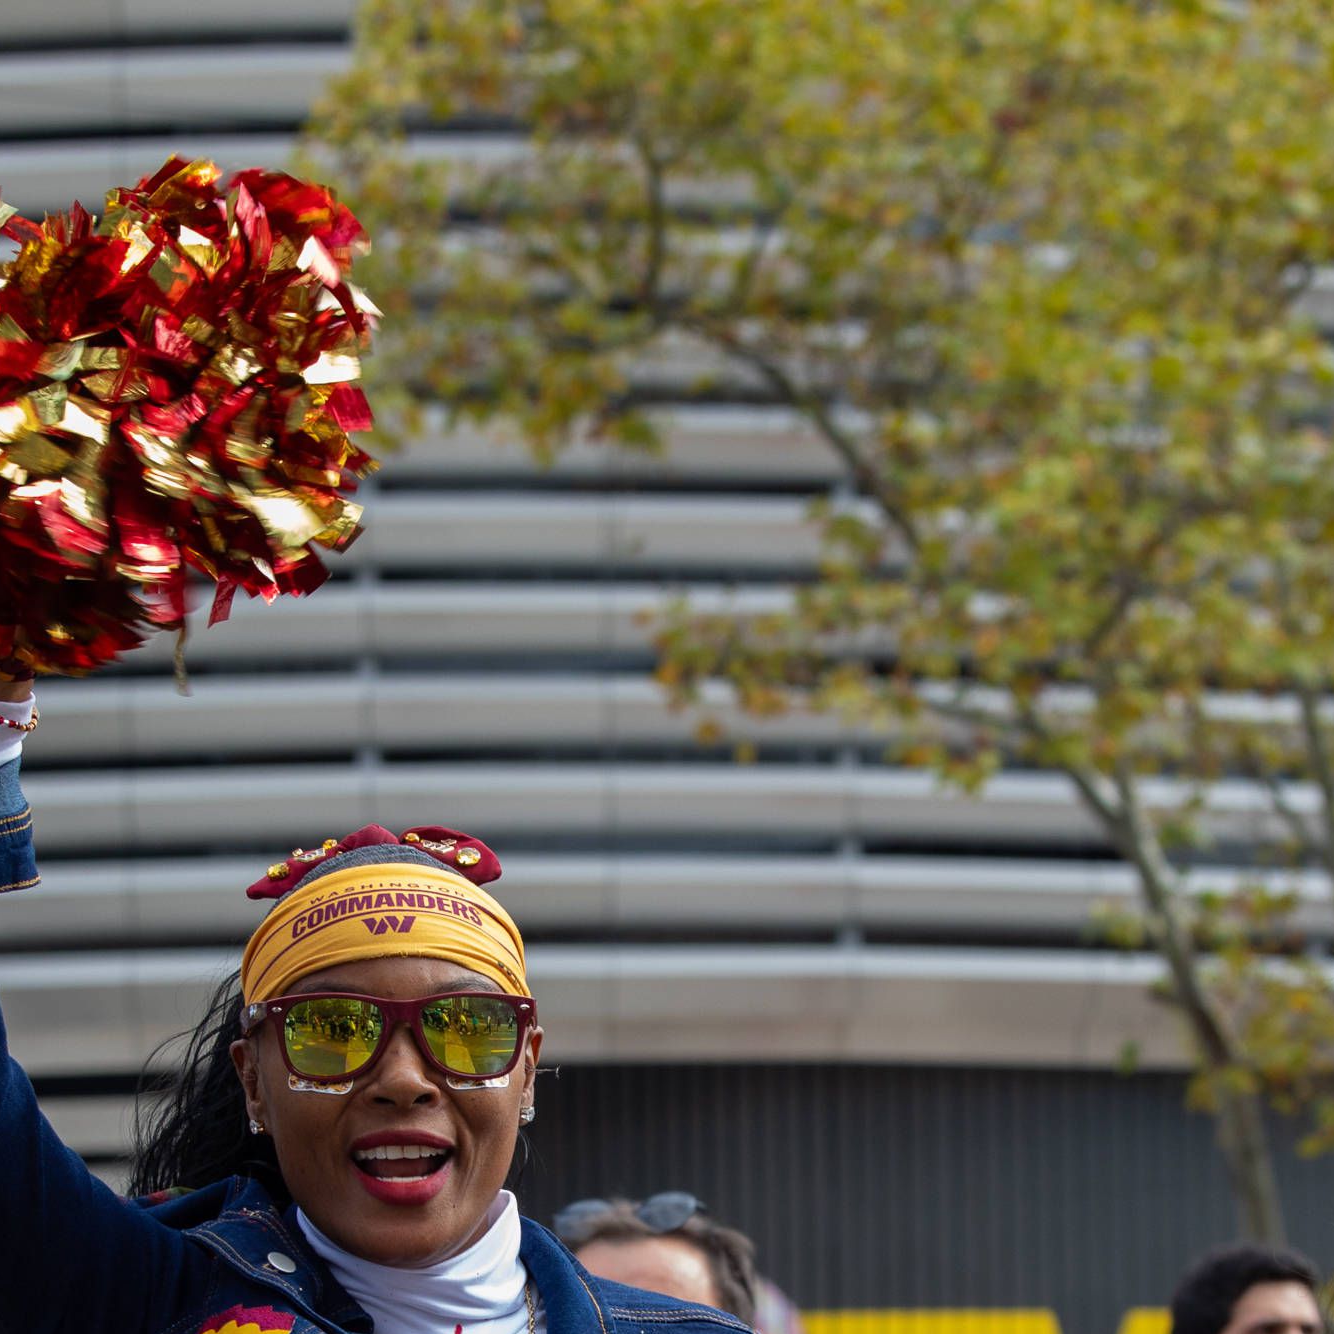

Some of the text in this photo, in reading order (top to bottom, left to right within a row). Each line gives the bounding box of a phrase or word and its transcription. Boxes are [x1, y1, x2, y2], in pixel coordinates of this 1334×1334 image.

[310, 883, 464, 904] WASHINGTON
[292, 893, 482, 938] COMMANDERS
[362, 916, 416, 935] W
